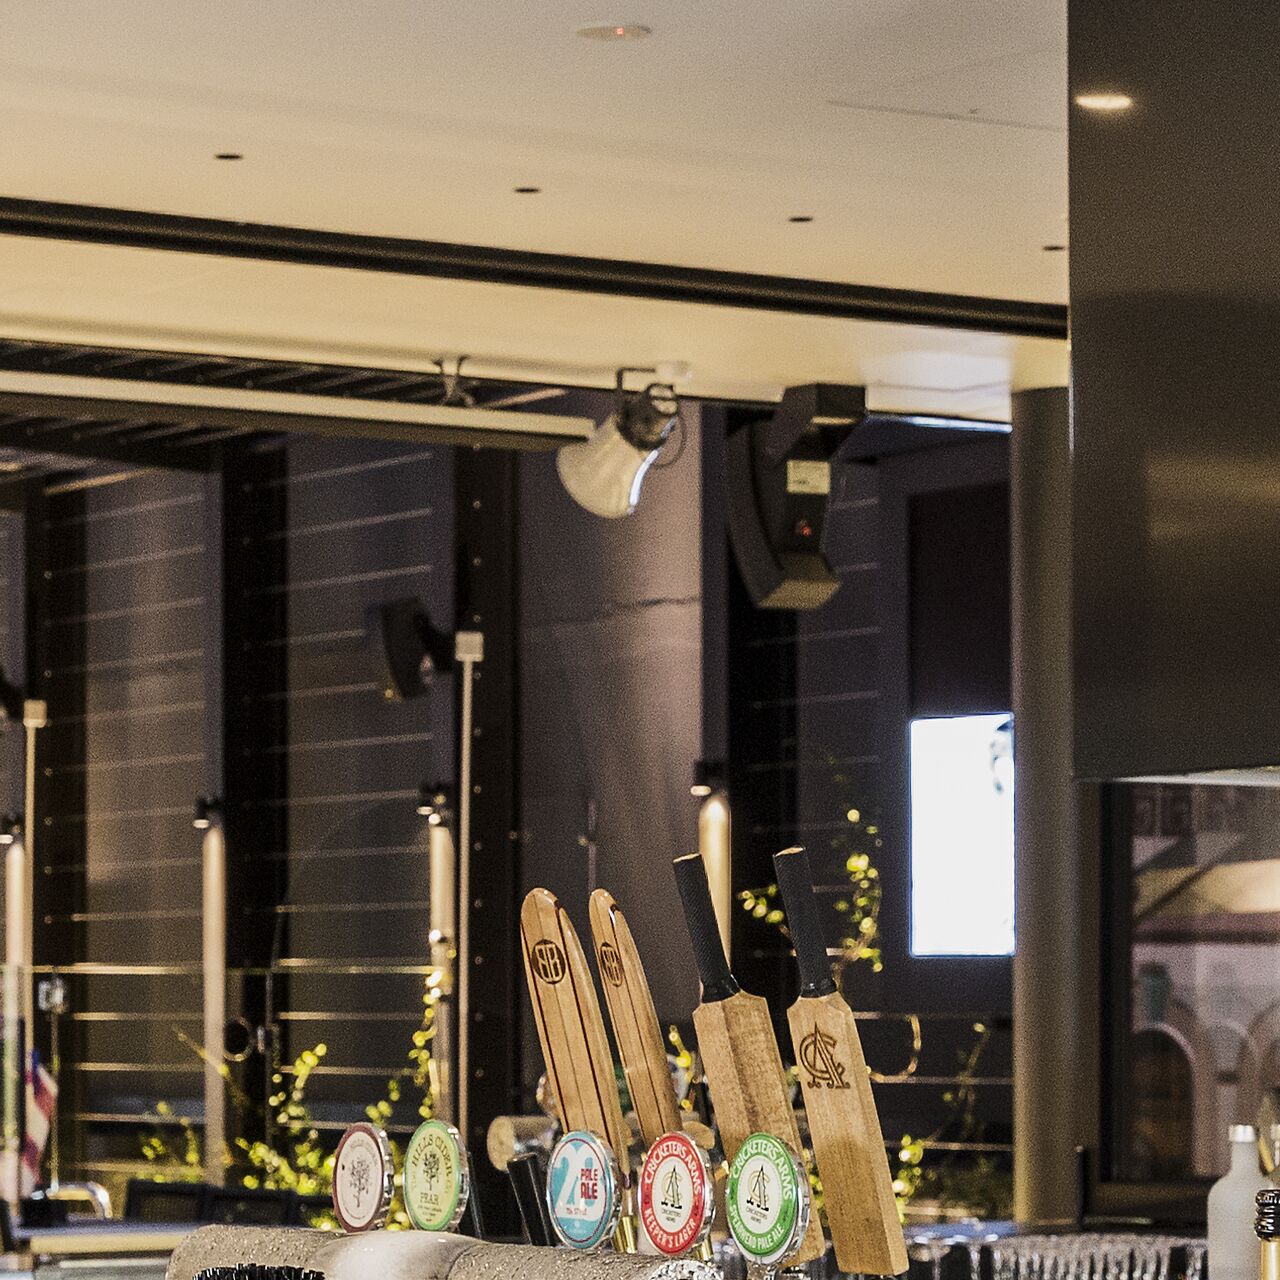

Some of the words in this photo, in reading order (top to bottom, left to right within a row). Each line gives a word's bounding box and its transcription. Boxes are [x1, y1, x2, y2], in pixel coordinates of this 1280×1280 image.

[580, 1168, 598, 1181] PALE
[685, 1155, 702, 1196] ARMS
[776, 1155, 793, 1201] ARMS
[580, 1182, 598, 1200] ALE
[674, 1218, 697, 1247] LAGER
